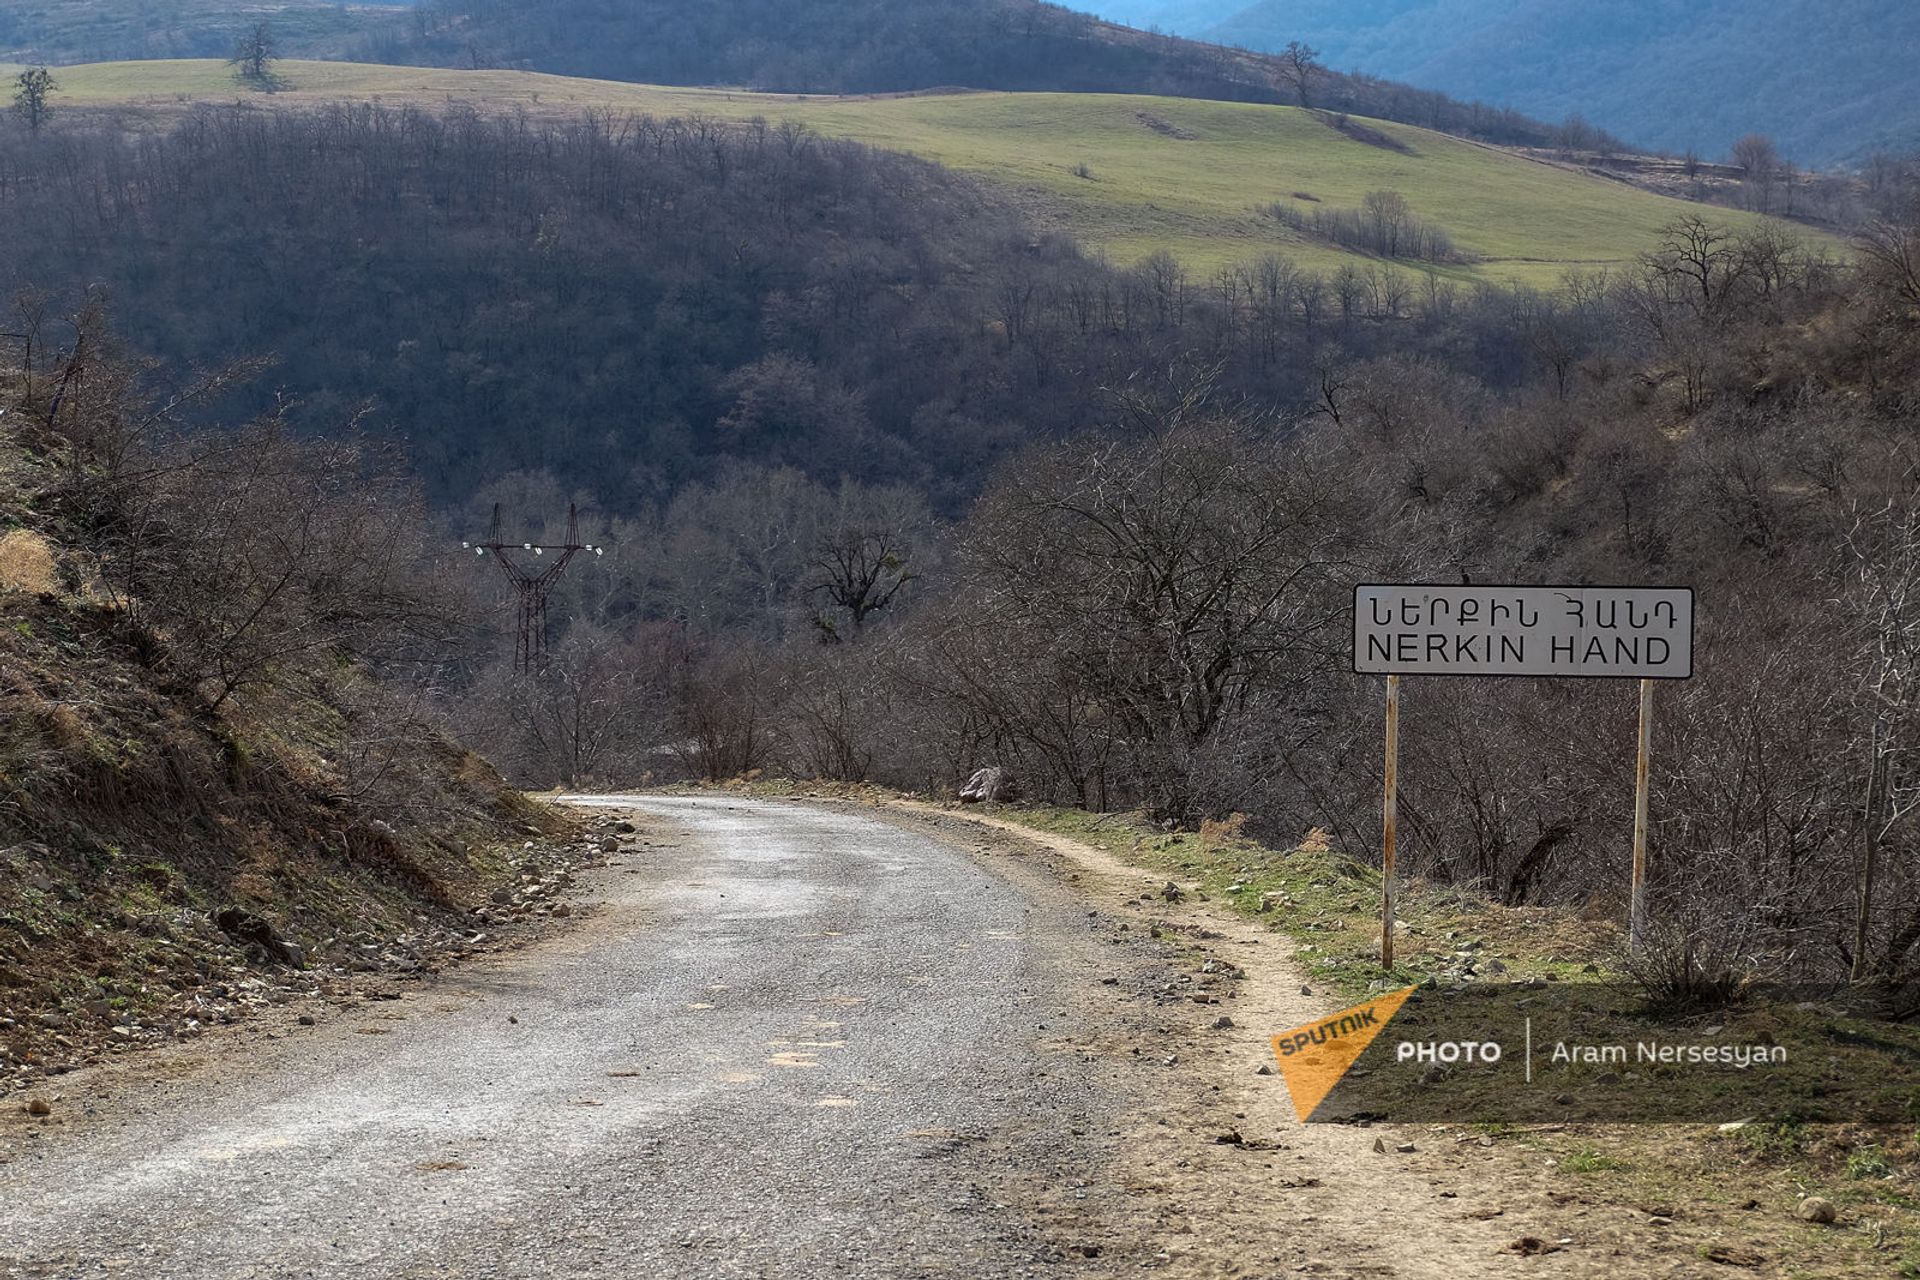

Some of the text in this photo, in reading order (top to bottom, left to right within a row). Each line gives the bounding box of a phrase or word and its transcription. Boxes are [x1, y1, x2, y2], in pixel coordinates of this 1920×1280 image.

[1369, 592, 1678, 629] ՆԵՐՔԻՆ ՀԱՆԴ
[1367, 633, 1671, 665] NERKIN HAND
